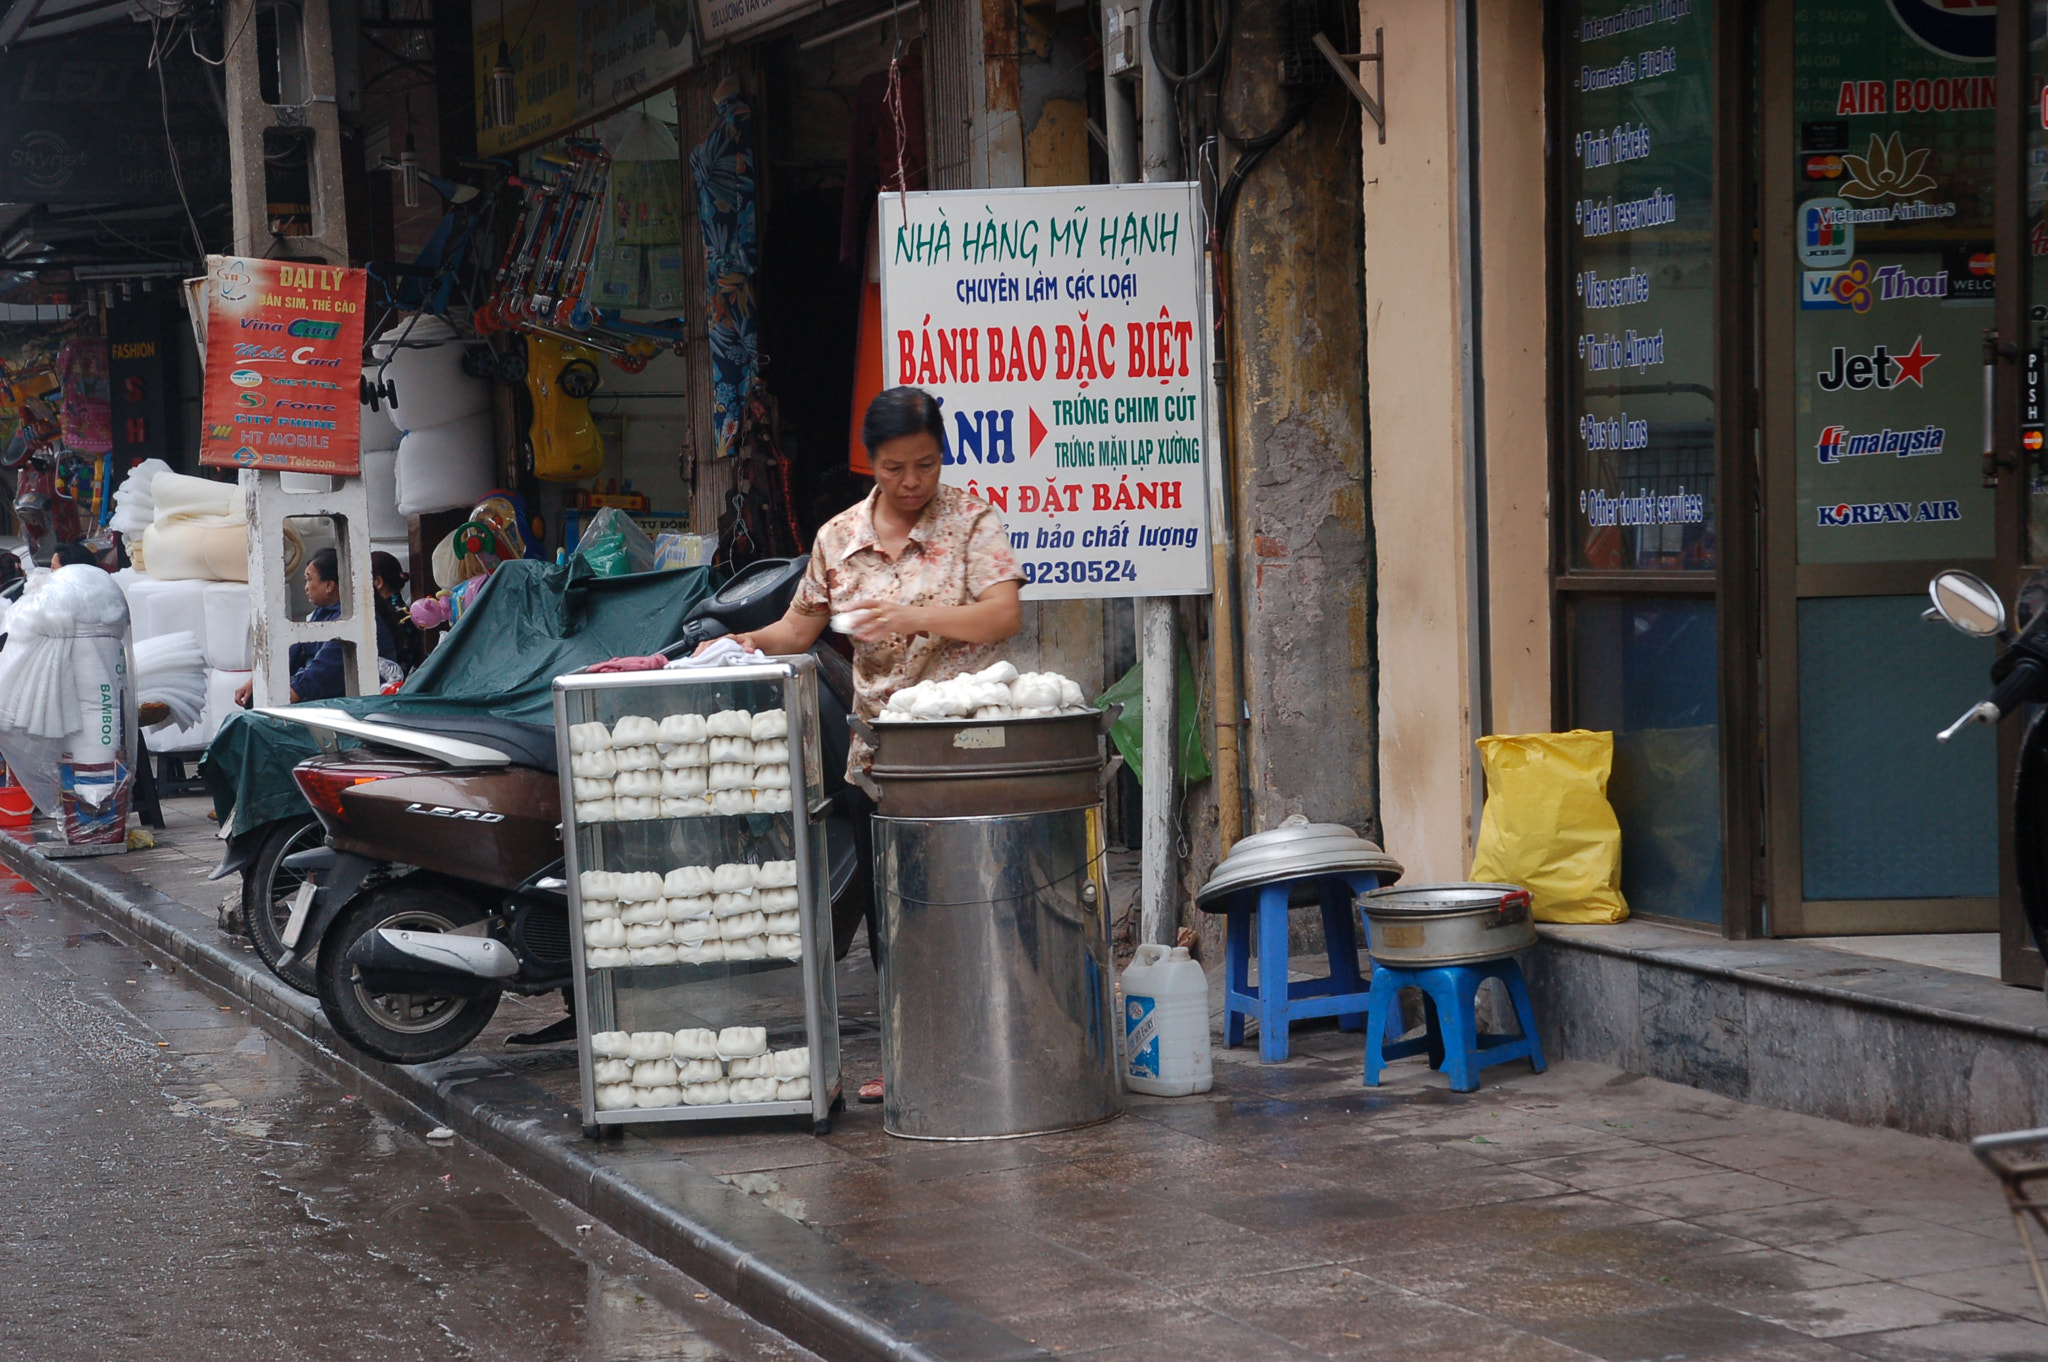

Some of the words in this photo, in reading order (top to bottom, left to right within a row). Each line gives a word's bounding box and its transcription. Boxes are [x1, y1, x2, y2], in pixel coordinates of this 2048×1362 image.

[1580, 0, 1655, 42] International
[1581, 56, 1637, 92] Domestic
[1639, 46, 1676, 80] Flight
[1836, 80, 1888, 116] AIR
[1583, 129, 1611, 169] Train
[1611, 122, 1651, 163] tickets
[1583, 195, 1613, 237] Hotel
[1613, 187, 1676, 232] reservation
[1817, 205, 1892, 226] Vietnam
[1891, 200, 1957, 222] Airlines
[895, 206, 951, 267] NHÀ
[962, 205, 1039, 267] HÀNG
[1049, 205, 1089, 259] MỸ
[1099, 211, 1179, 266] HẠNH
[280, 266, 314, 292] ĐẠI
[320, 267, 344, 291] LÝ
[956, 272, 1019, 305] CHUYÊN
[1025, 270, 1058, 304] LÀM
[1065, 269, 1095, 300] CÁC
[1100, 273, 1138, 306] LOẠI
[1584, 270, 1608, 308] Visa
[1608, 266, 1649, 308] service
[1872, 264, 1949, 301] Thai
[1953, 279, 1995, 290] WELC
[259, 293, 282, 308] BÁN
[284, 296, 309, 311] SIM,
[312, 296, 332, 312] THẺ
[334, 299, 356, 314] CÀO
[240, 317, 283, 333] Vina
[287, 318, 342, 339] Card
[112, 341, 156, 360] FASHION
[233, 342, 286, 361] Mobi
[291, 346, 342, 368] Card
[897, 313, 980, 385] BÁNH
[987, 325, 1047, 384] BAO
[1054, 308, 1116, 389] ĐẶC
[1127, 305, 1193, 385] BIỆT
[1586, 333, 1610, 371] Taxi
[1610, 334, 1623, 370] to
[1624, 328, 1665, 375] Airport
[1817, 345, 1894, 391] Jet
[2027, 353, 2039, 420] PUSH
[234, 413, 273, 425] CITY
[278, 416, 337, 431] PHONE
[274, 400, 336, 412] Fone
[1052, 392, 1109, 426] TRỨNG
[1114, 396, 1159, 424] CHIM
[1164, 387, 1196, 422] CÚT
[240, 430, 264, 444] HT
[268, 432, 330, 449] MOBILE
[1586, 413, 1607, 451] Bus
[1608, 416, 1621, 450] to
[1621, 412, 1648, 450] Laos
[1848, 425, 1945, 459] malaysia
[263, 453, 288, 465] EVN
[289, 454, 336, 469] Telecom
[1054, 434, 1095, 468] TRỨNG
[1099, 434, 1128, 472] MẶN
[1131, 439, 1154, 472] LẠP
[1158, 430, 1200, 465] XƯỜNG
[1018, 476, 1083, 519] ĐẶT
[1091, 474, 1182, 511] BÁNH
[1587, 488, 1619, 527] Other
[1618, 487, 1656, 525] tourist
[1656, 485, 1703, 524] services
[1817, 501, 1911, 527] KOREAN
[1914, 500, 1962, 522] AIR
[1035, 523, 1075, 549] bảo
[1081, 520, 1130, 548] chất
[1138, 524, 1199, 552] lượng
[1021, 559, 1138, 585] 9230524
[100, 684, 112, 746] BAMBOO
[404, 803, 505, 823] LEAD
